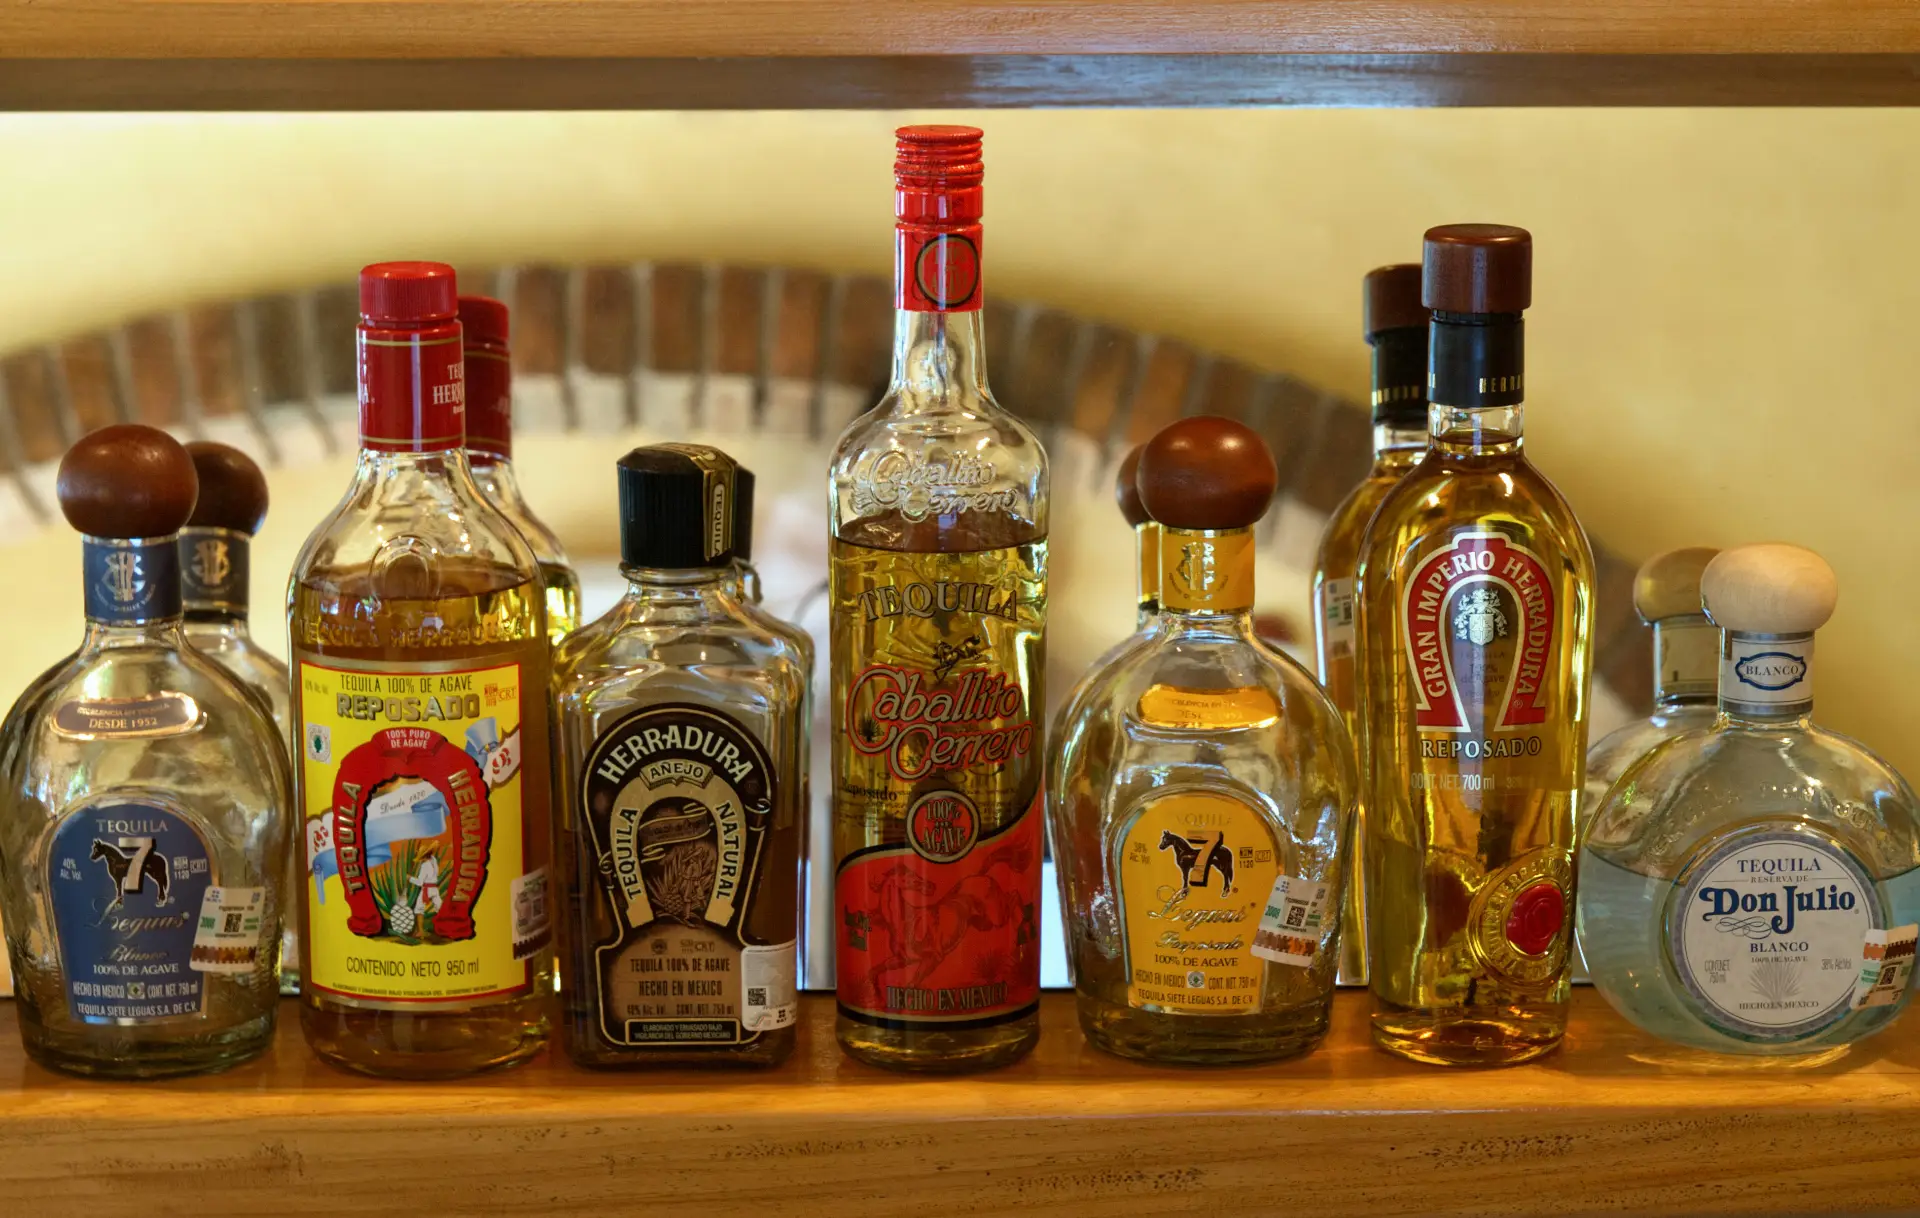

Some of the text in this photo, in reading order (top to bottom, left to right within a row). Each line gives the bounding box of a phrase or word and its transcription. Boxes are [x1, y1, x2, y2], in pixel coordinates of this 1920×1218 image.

[900, 485, 1019, 523] Cerrero
[713, 490, 723, 557] TEQUILA
[858, 581, 1018, 622] TEQUILA
[1417, 550, 1548, 698] GRAN IMPERIO HERRADURA
[1745, 664, 1799, 676] BLANCO
[340, 674, 382, 692] TEQUILA
[387, 677, 415, 694] 100%
[420, 678, 432, 693] DE
[439, 675, 473, 692] AGAVE
[336, 692, 481, 722] REPOSADO
[847, 665, 1022, 756] Caballito
[89, 717, 157, 729] DESDE 1952
[386, 729, 431, 740] 100% PURO
[391, 739, 428, 749] DE AGAVE
[888, 721, 1034, 782] Cerrero
[1421, 736, 1541, 758] REPOSADO
[597, 725, 753, 784] HERRADURA
[650, 761, 704, 779] AÑEJO
[1462, 774, 1481, 790] 700
[1483, 773, 1495, 790] ml
[380, 790, 426, 815] Desde 1870
[927, 799, 962, 820] 100%
[96, 819, 168, 836] TEQUILA
[448, 768, 482, 902] HERRADURA
[338, 781, 365, 896] TEQUILA
[923, 828, 965, 853] AGAVE
[616, 808, 641, 900] TEQUILA
[715, 802, 739, 900] NATURAL
[1186, 831, 1224, 887] 7
[62, 857, 76, 870] 40%
[119, 837, 156, 893] 7
[1239, 860, 1254, 868] 1120
[1737, 858, 1822, 875] TEQUILA
[174, 870, 190, 880] 1120
[1751, 875, 1809, 883] RESERVA DE
[1698, 885, 1856, 935] Don Julio
[1750, 942, 1809, 953] BLANCO
[93, 963, 179, 975] 100% DE AGAVE
[346, 957, 479, 976] CONTENIDO NETO 950 ml
[631, 958, 731, 973] TEQUILA 100% DE AGAVE
[1155, 954, 1239, 967] 100% DE AGAVE
[1135, 969, 1186, 988] HECHO EN MEXICO
[1239, 976, 1249, 988] 750
[1250, 976, 1257, 987] ml
[73, 982, 125, 998] HECHO EN MEXICO
[179, 982, 189, 995] 750
[190, 981, 198, 994] ml
[639, 980, 722, 996] HECHO EN MEXICO
[886, 981, 1008, 1011] HECHO EN MEXICO
[1138, 989, 1165, 1002] TEQUILA
[1167, 992, 1186, 1004] SIETE
[1188, 994, 1215, 1005] LEGUAS
[1232, 995, 1241, 1005] DE
[77, 1000, 197, 1017] TEQUILA SIETE LEGUAS S.A. DE C.V.
[1739, 1001, 1819, 1010] HECHO EN MEXICO
